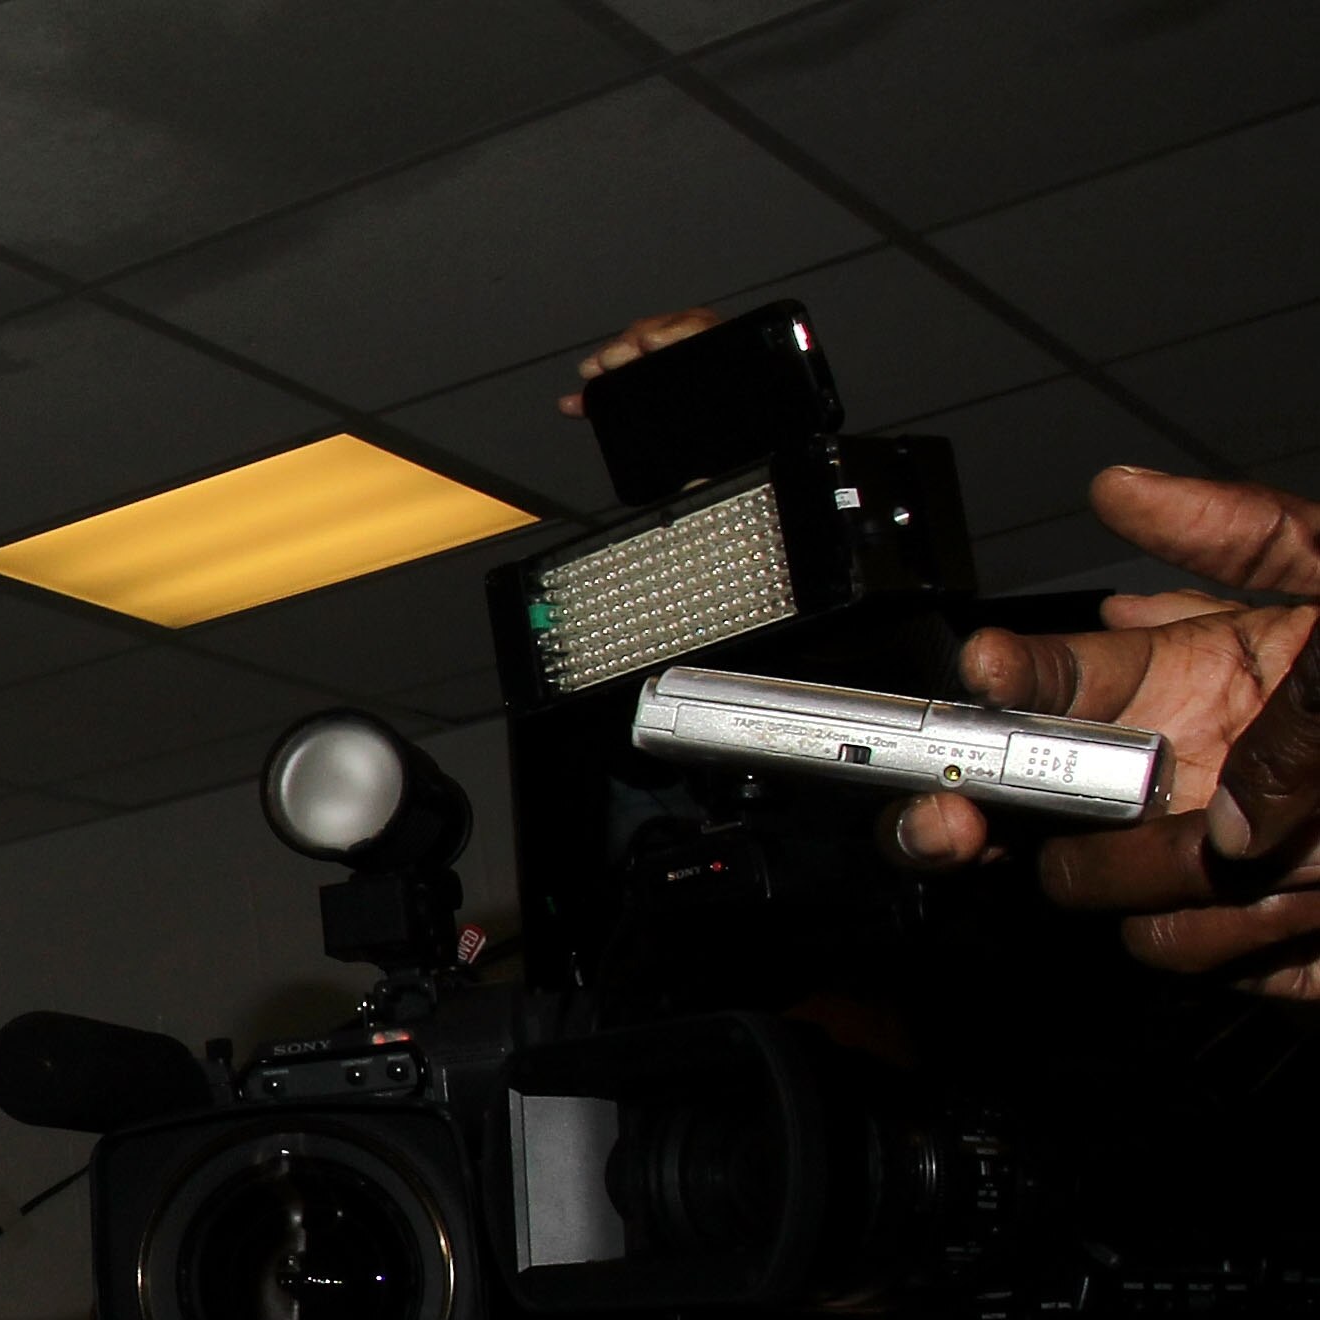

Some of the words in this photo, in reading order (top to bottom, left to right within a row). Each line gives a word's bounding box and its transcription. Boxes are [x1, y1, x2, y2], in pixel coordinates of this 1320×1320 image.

[927, 744, 946, 756] DC
[967, 749, 986, 761] 3V
[1062, 749, 1079, 784] OPEN
[273, 1039, 332, 1057] SONY
